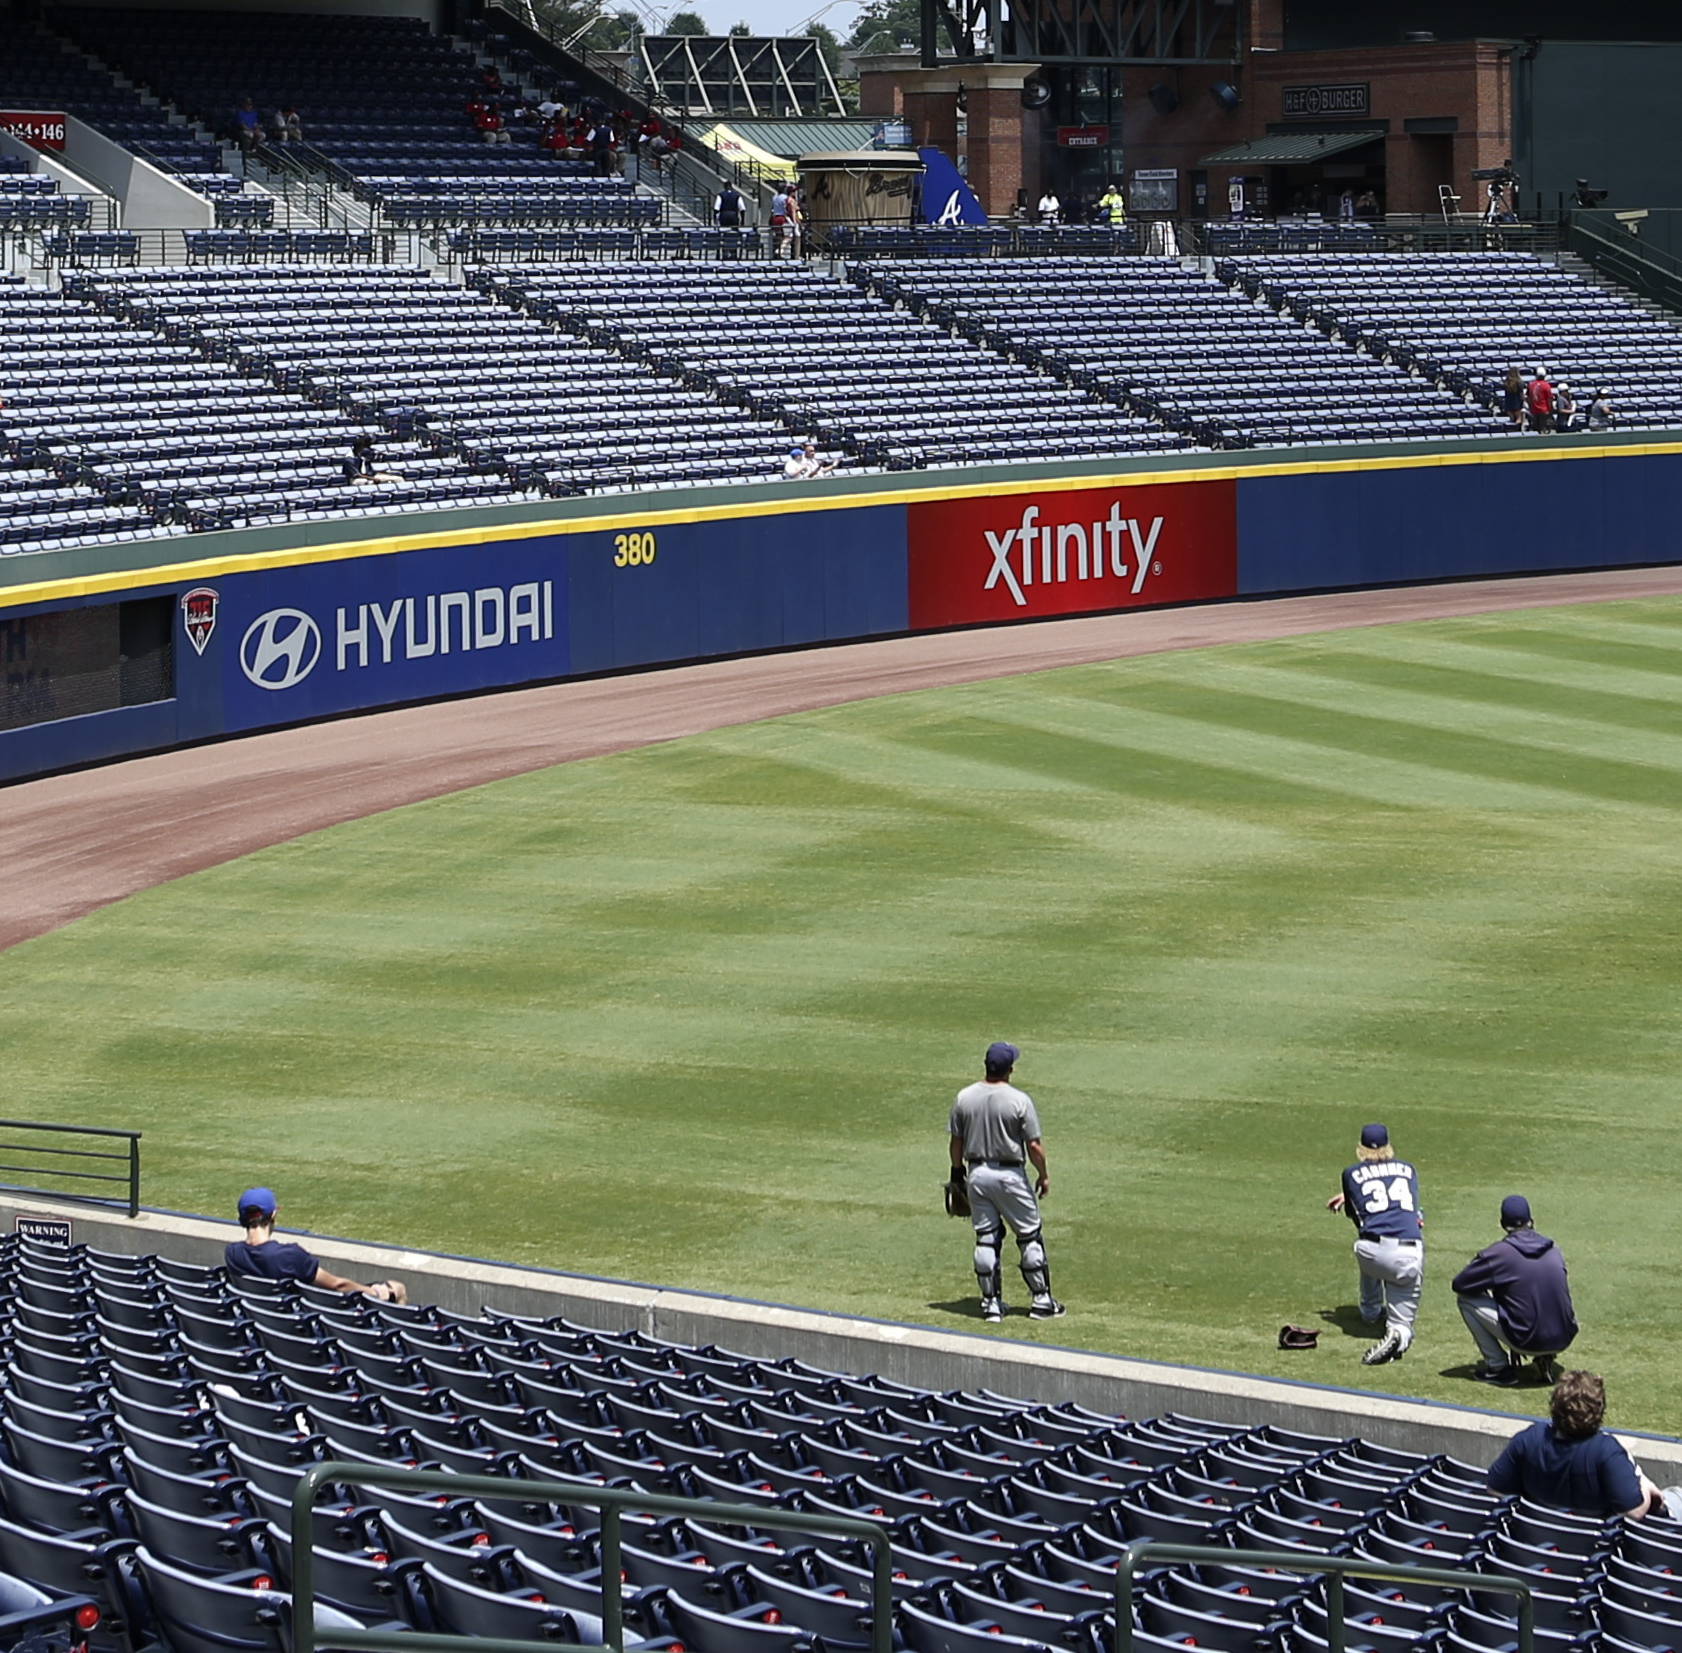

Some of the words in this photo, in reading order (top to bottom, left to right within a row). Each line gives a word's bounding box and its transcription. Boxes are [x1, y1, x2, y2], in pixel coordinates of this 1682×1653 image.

[1322, 90, 1364, 109] BURGER
[41, 124, 64, 140] 146
[613, 531, 655, 568] 380
[983, 501, 1164, 606] xfinity
[337, 580, 553, 671] HYUNDAI
[1361, 1177, 1414, 1213] 34
[20, 1224, 68, 1238] WARNING
